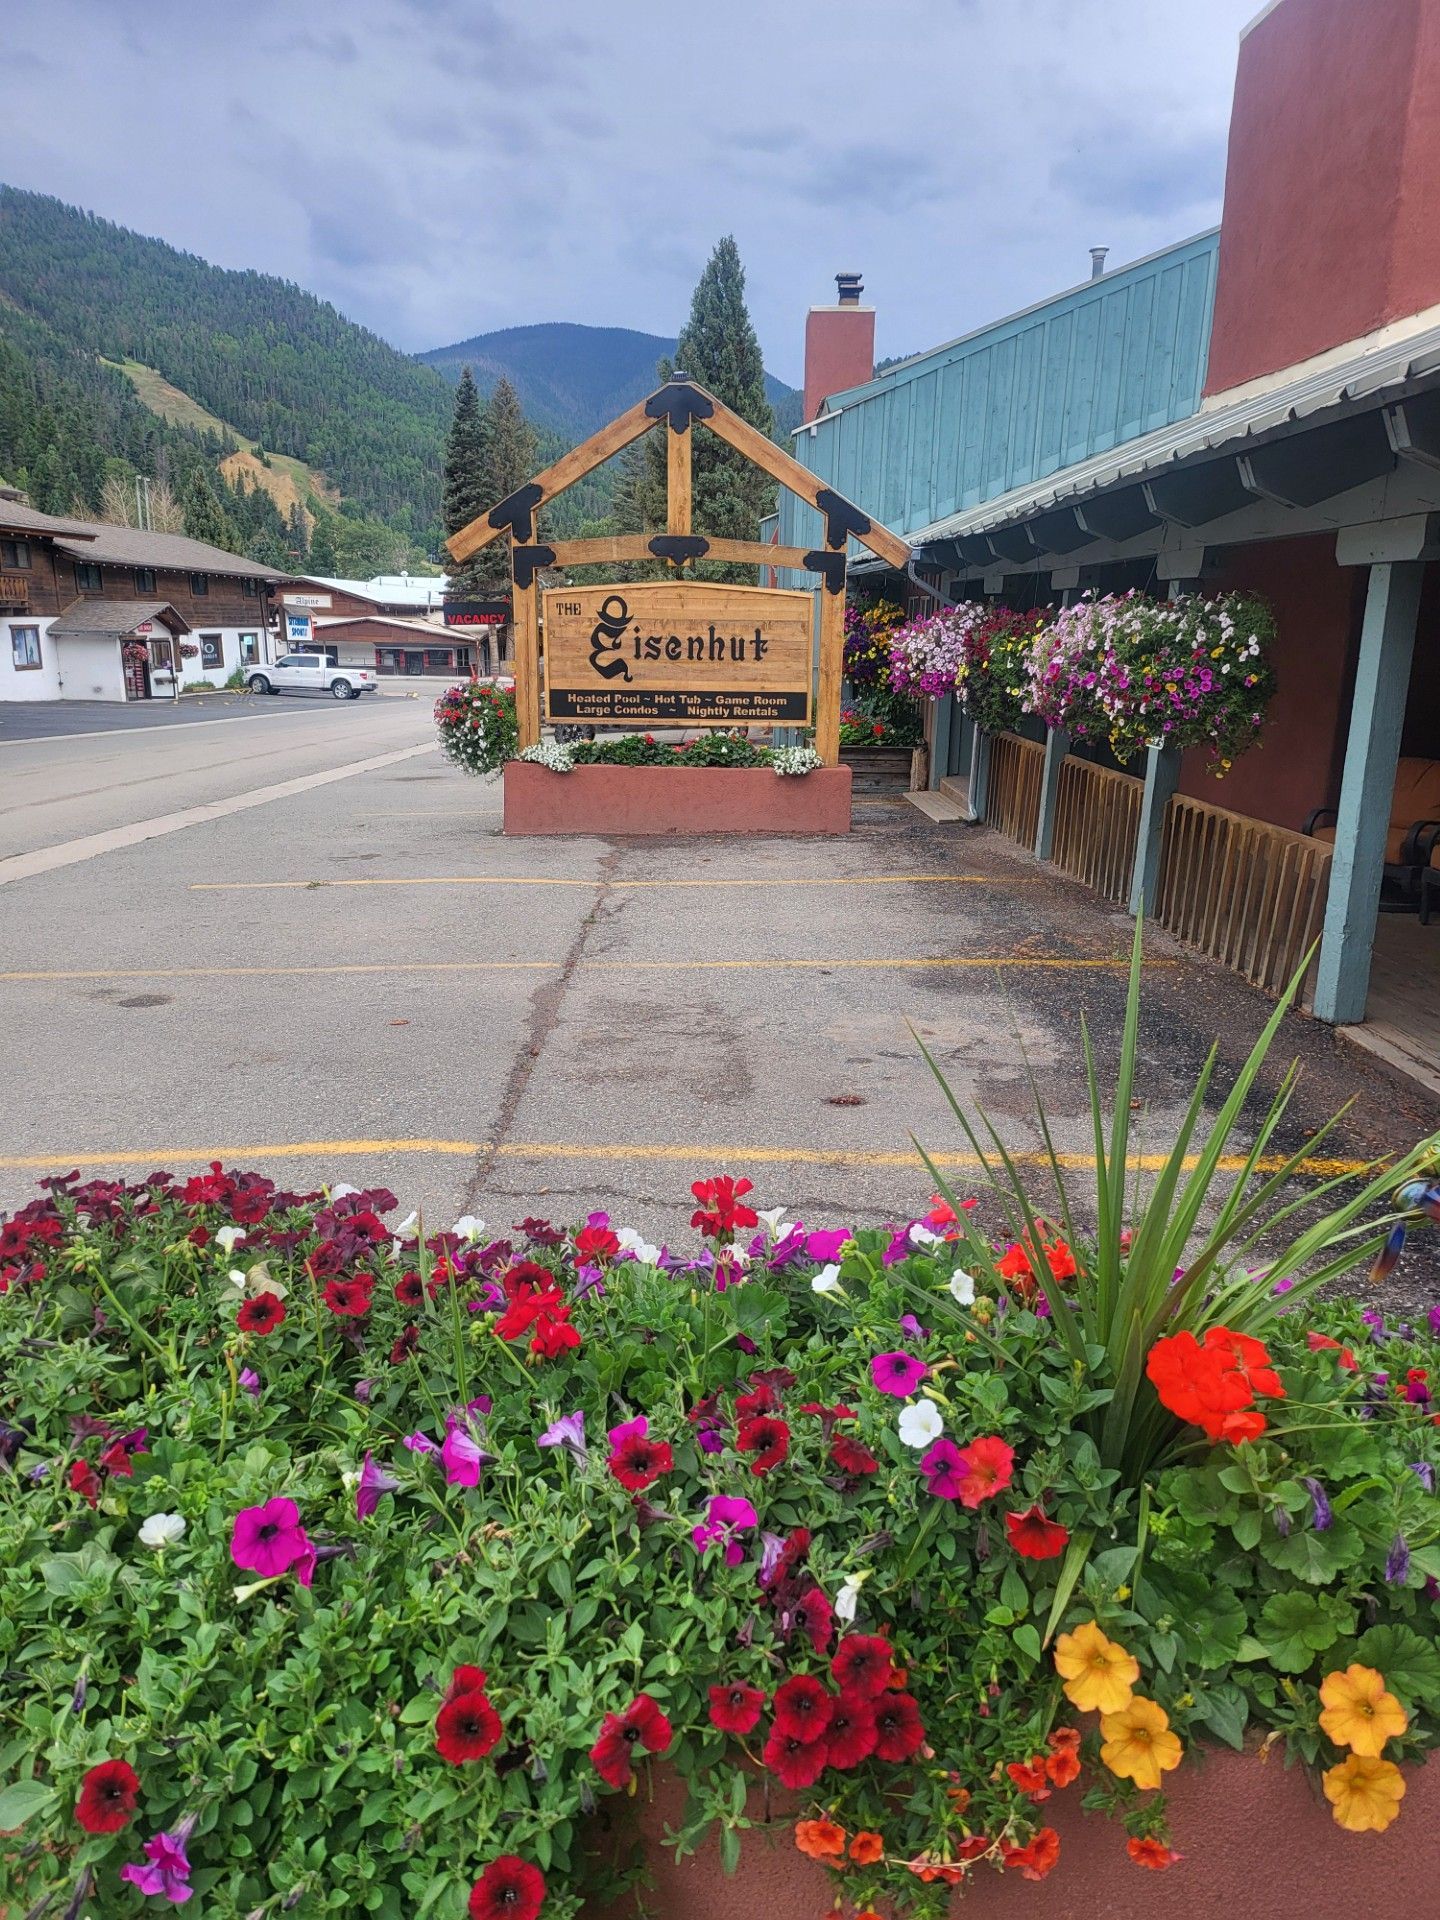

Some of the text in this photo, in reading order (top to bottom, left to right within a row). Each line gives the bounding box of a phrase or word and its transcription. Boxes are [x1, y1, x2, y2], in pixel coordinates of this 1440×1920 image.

[447, 614, 506, 625] VACANCY
[555, 595, 769, 683] THE Eisenhut
[567, 693, 611, 704] Heated
[614, 694, 641, 704] Pool
[654, 694, 676, 705] Hot
[679, 695, 701, 705] Tub
[715, 696, 750, 705] Game
[754, 696, 788, 705] Room
[576, 705, 611, 716] Large
[614, 705, 659, 715] Condos
[687, 706, 729, 717] Nightly
[733, 706, 778, 716] Rentals
